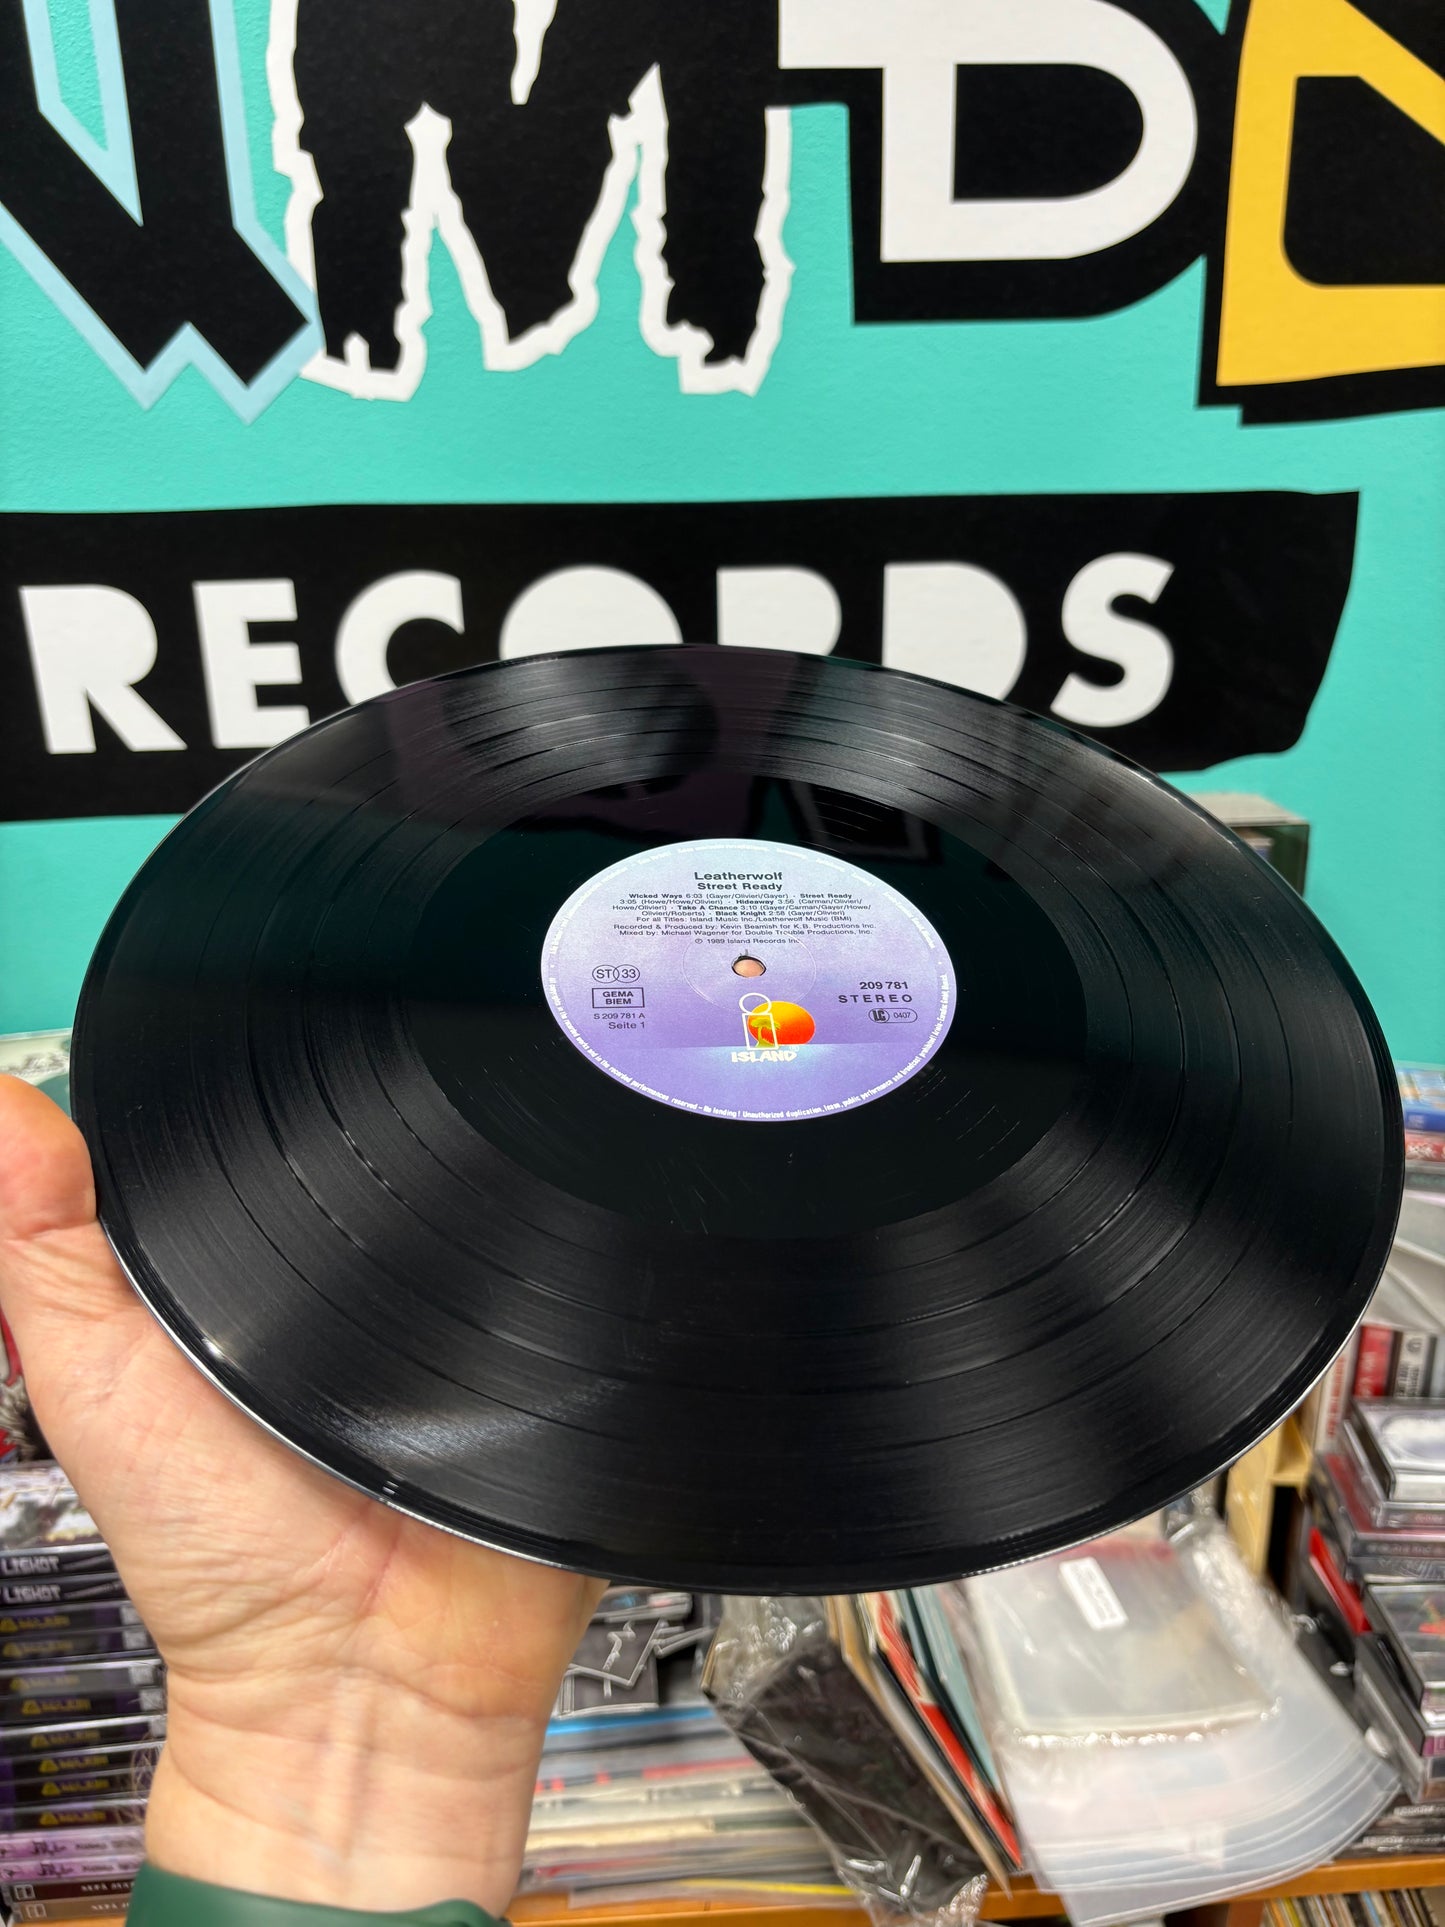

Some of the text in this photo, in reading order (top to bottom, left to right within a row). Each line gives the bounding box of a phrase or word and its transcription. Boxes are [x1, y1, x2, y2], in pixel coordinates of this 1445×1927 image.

[694, 872, 783, 880] Leatherwolf
[742, 883, 782, 891] Ready
[596, 969, 636, 979] ST 33
[859, 981, 908, 990] 209 781
[838, 994, 912, 1003] STEREO
[872, 1010, 886, 1022] LC
[731, 1050, 797, 1062] ISLAND
